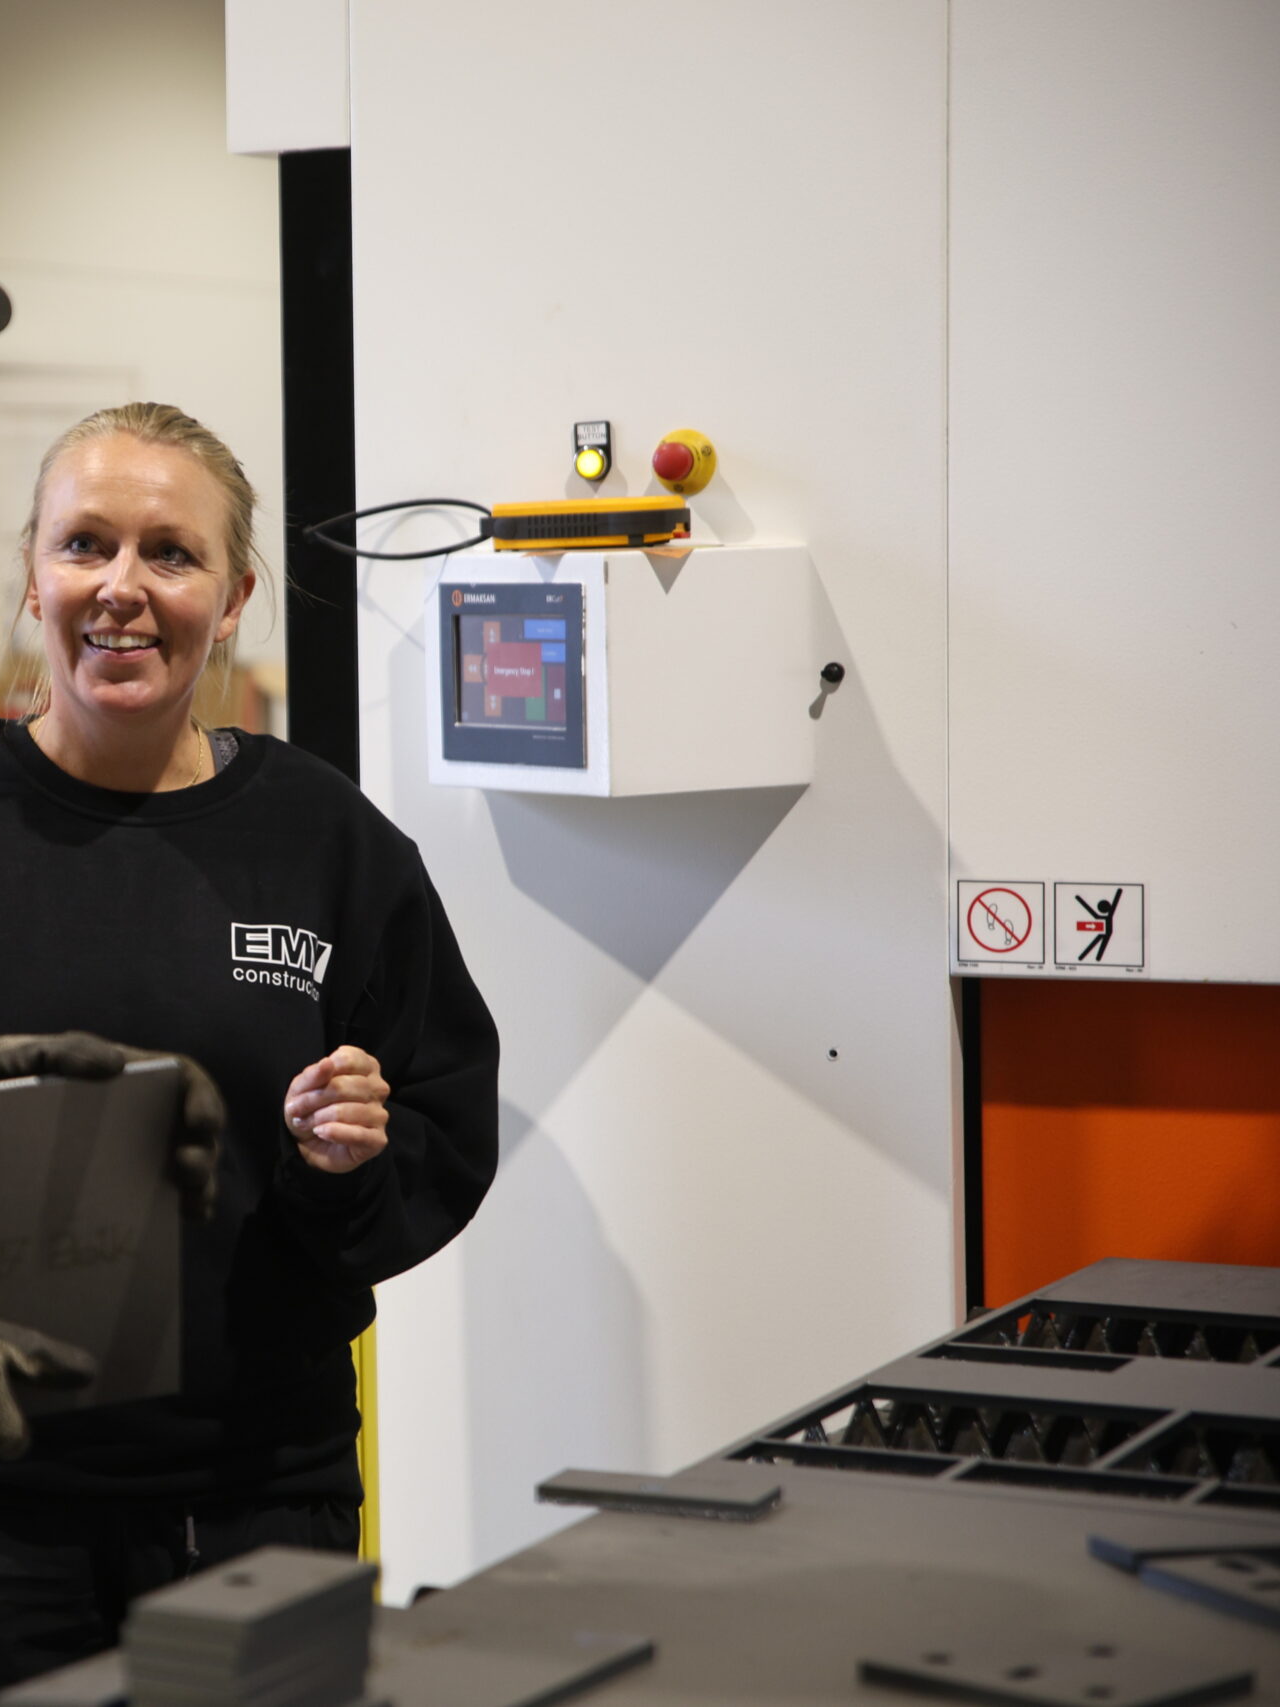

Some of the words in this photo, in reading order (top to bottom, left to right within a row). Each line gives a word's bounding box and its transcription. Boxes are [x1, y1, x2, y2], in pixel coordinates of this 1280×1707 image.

[582, 423, 600, 432] TEST
[578, 432, 606, 441] BUTTON
[464, 593, 495, 603] ERMAKSAN
[494, 667, 518, 677] Emergency
